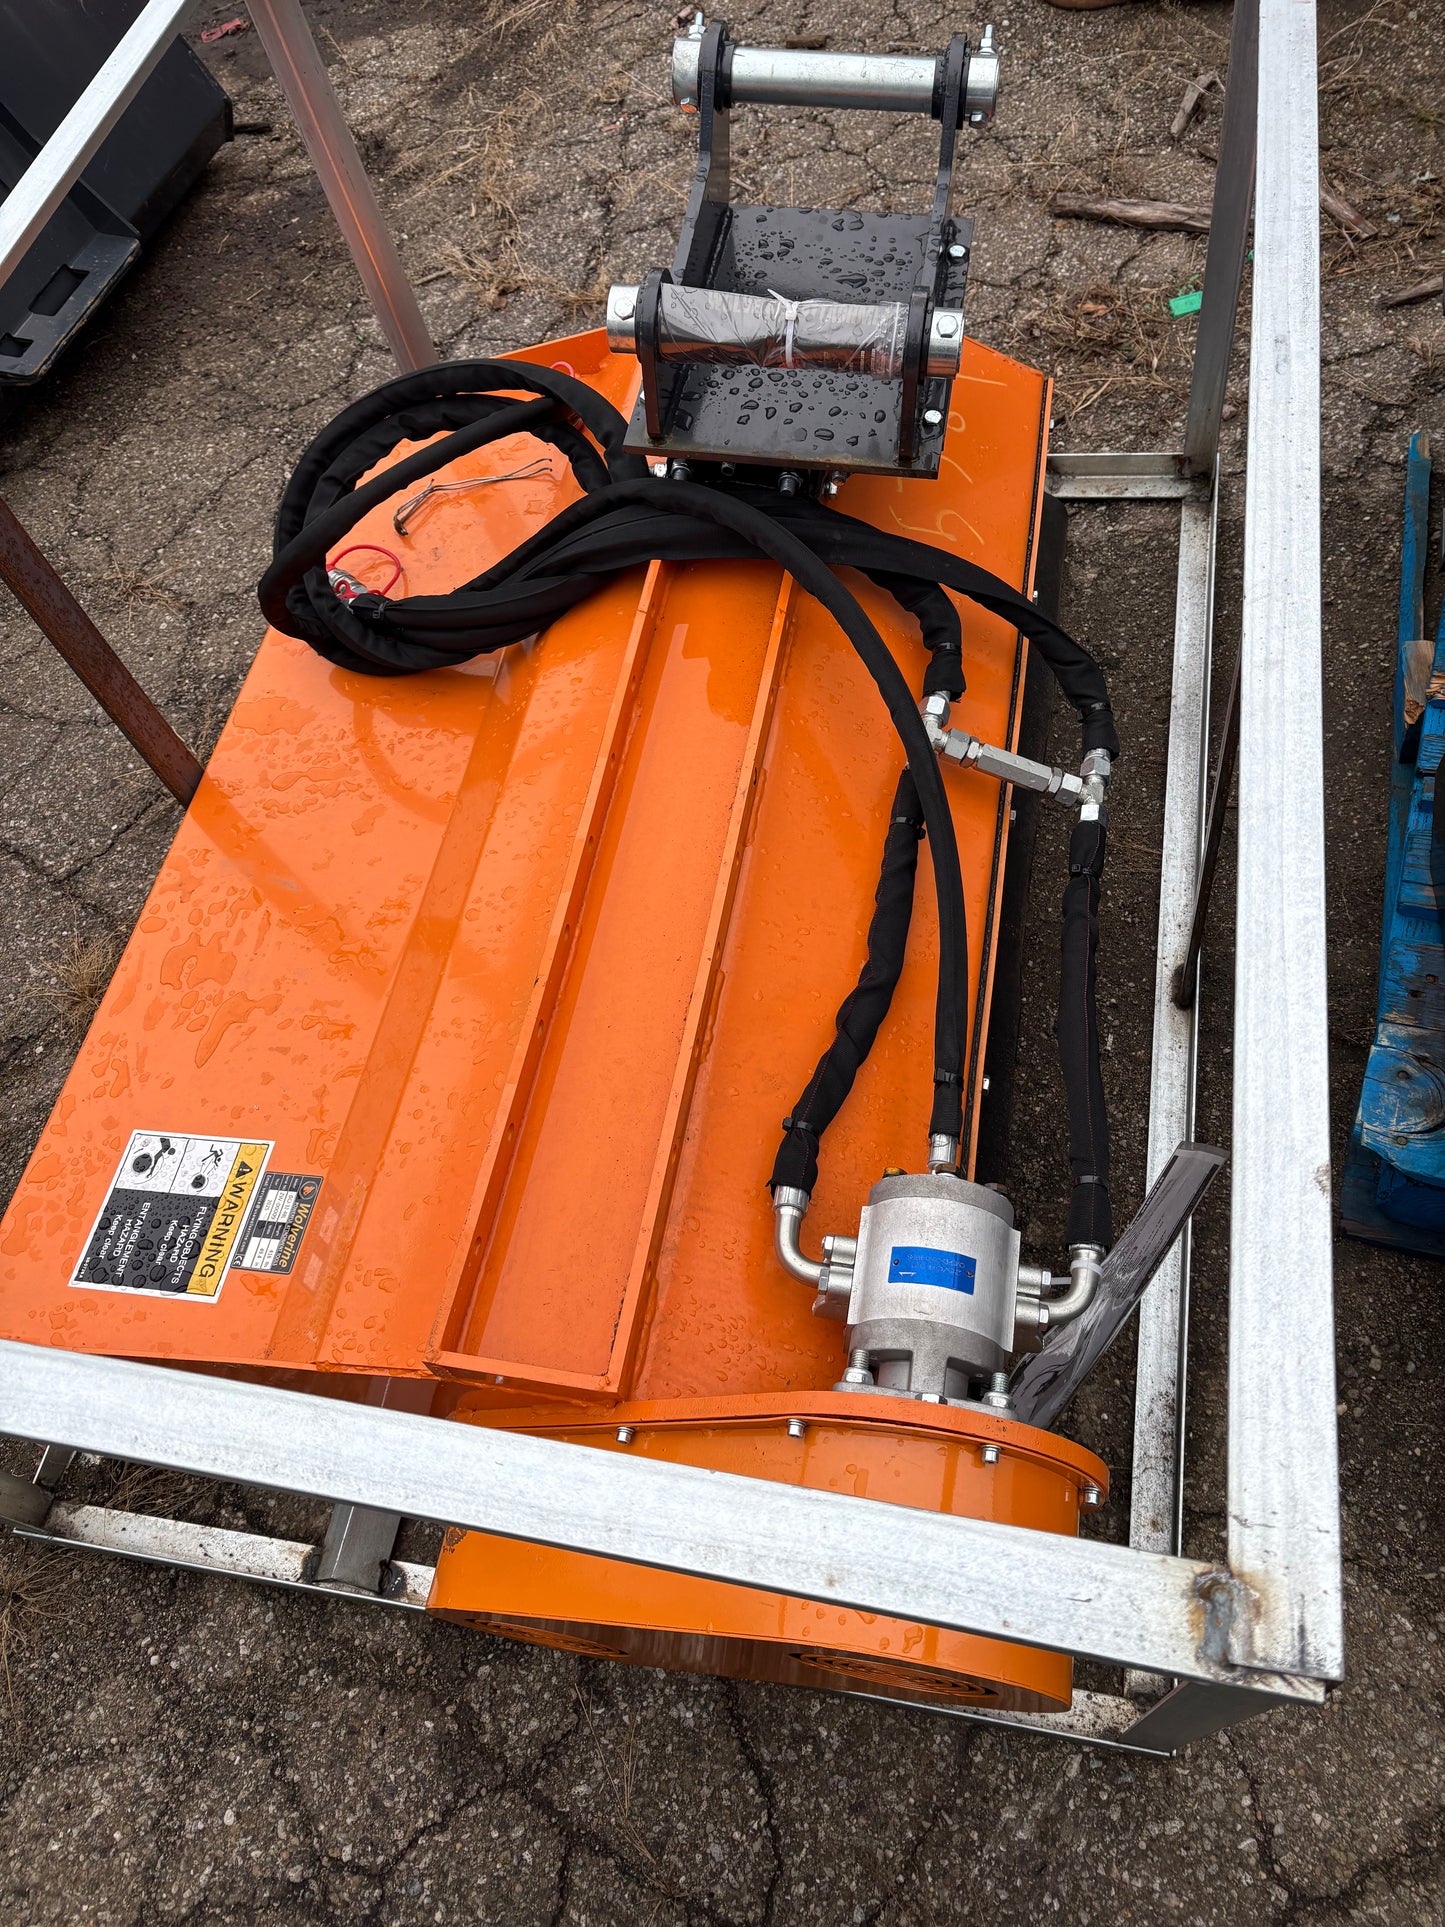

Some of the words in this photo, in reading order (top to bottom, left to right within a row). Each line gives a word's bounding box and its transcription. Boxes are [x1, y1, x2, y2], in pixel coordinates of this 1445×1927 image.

[107, 1213, 123, 1235] Keep
[111, 1218, 134, 1257] HAZARD
[113, 1201, 151, 1277] ENTANGLEMENT
[162, 1219, 178, 1241] Keep
[187, 1205, 207, 1240] FLYING
[196, 1180, 248, 1279] WARNING
[277, 1202, 312, 1268] Wolverine
[97, 1237, 113, 1259] clear
[153, 1243, 169, 1265] clear
[168, 1224, 190, 1263] HAZARD
[169, 1239, 194, 1284] OBJECTS
